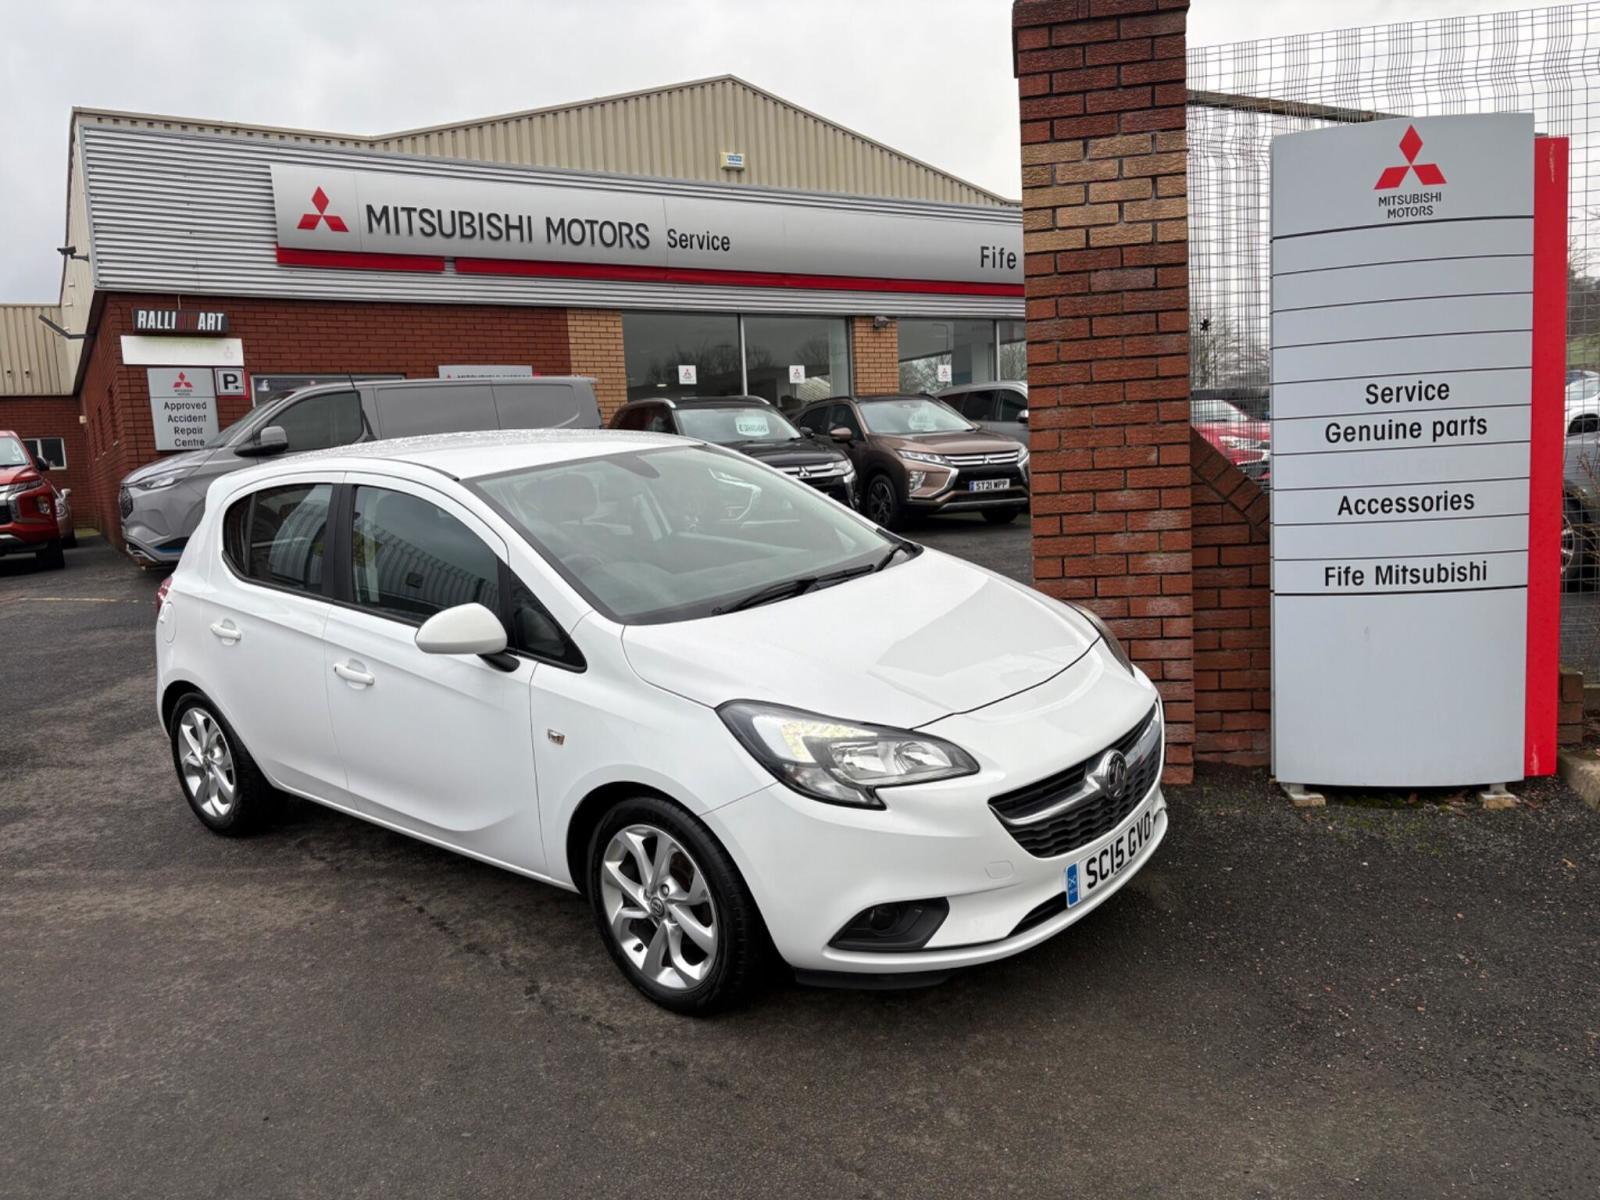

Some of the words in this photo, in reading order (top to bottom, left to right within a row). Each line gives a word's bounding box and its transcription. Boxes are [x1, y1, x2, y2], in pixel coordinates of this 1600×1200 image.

[1378, 192, 1442, 207] MITSUBISHI
[1387, 205, 1434, 219] MOTORS
[366, 204, 533, 243] MITSUBISHI
[546, 216, 650, 250] MOTORS
[667, 228, 731, 252] Service
[980, 246, 1017, 270] Fife
[223, 373, 238, 390] P
[1366, 380, 1450, 405] Service
[163, 401, 207, 412] Approved
[167, 413, 207, 423] Accident
[174, 426, 203, 437] Repair
[1325, 418, 1422, 444] Genuine
[1432, 415, 1488, 443] parts
[174, 438, 205, 448] Centre
[1338, 490, 1475, 516] Accessories
[1325, 565, 1365, 587] Fife
[1375, 560, 1488, 586] Mitsubishi
[1085, 836, 1125, 889] SC15
[1127, 810, 1151, 858] GVO
